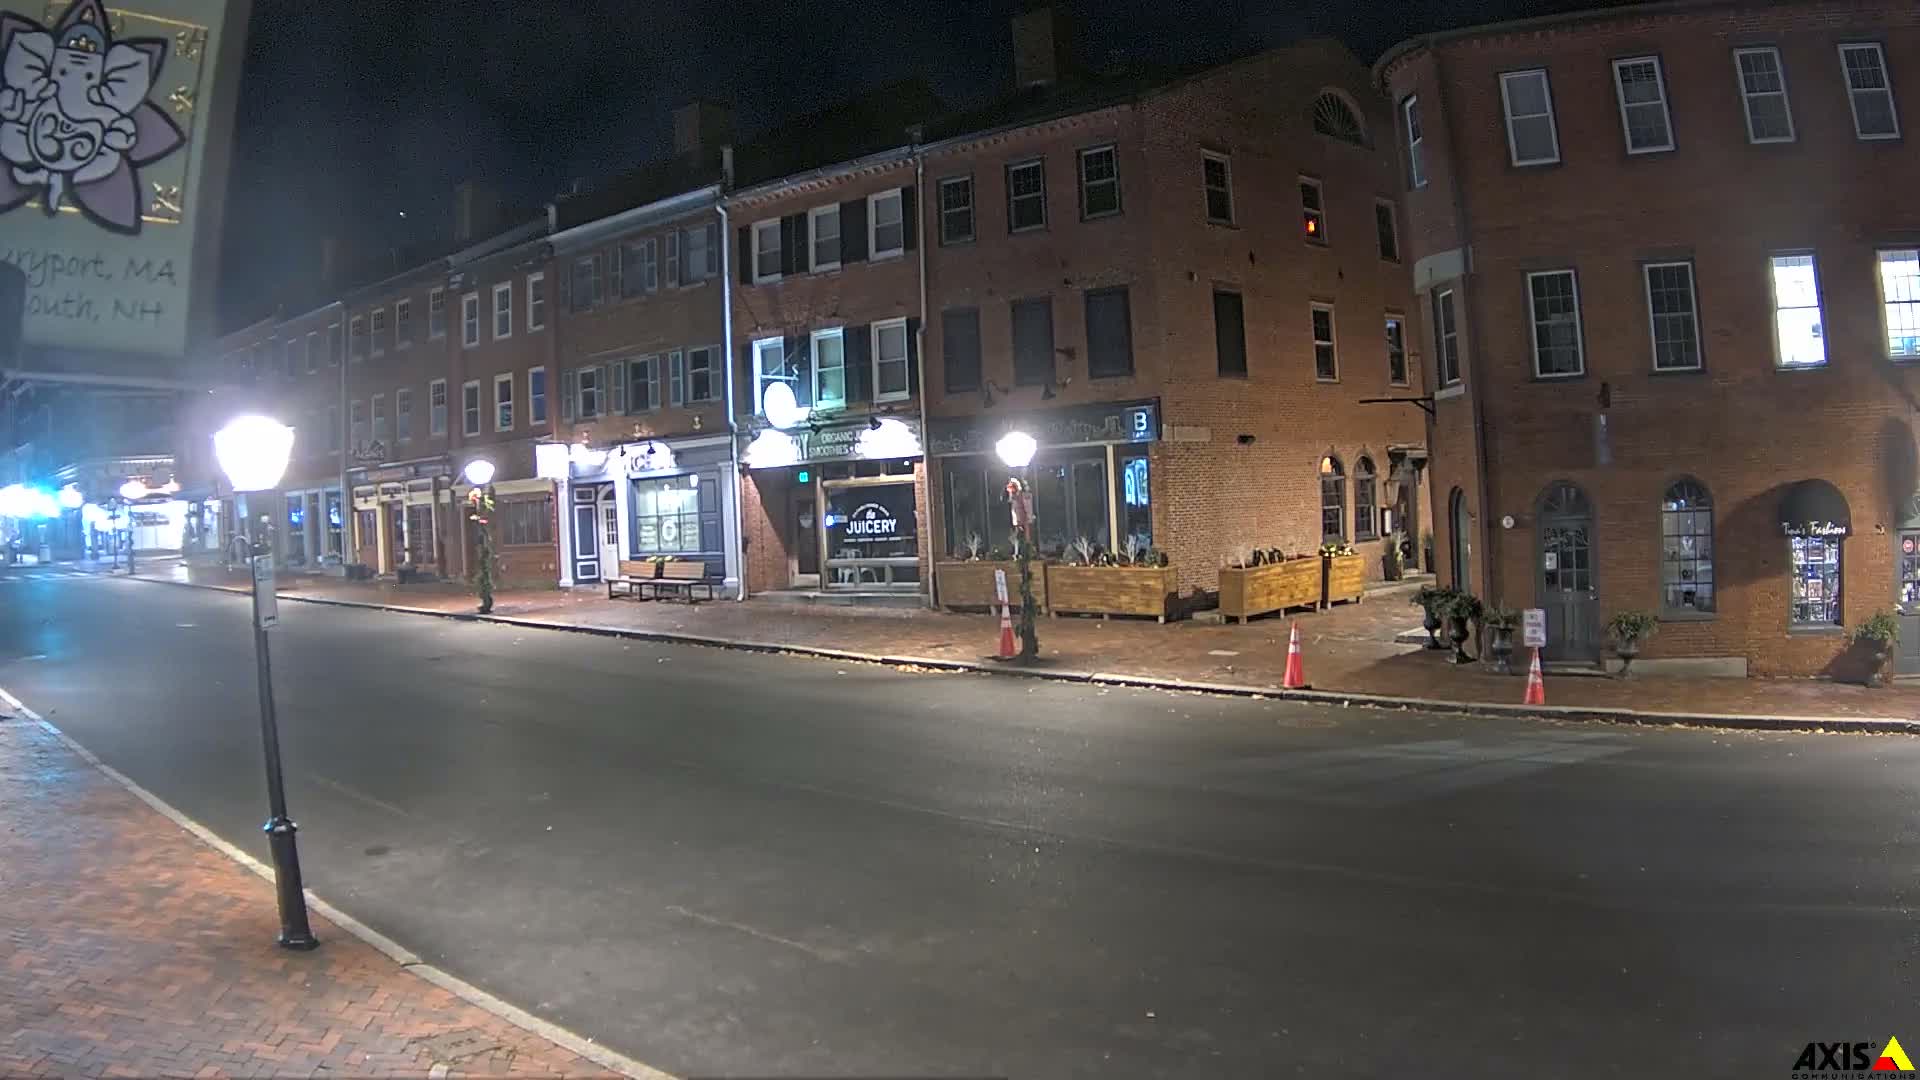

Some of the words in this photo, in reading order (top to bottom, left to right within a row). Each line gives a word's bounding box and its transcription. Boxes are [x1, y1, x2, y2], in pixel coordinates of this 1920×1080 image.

[123, 257, 176, 286] MA
[112, 299, 162, 323] NH
[1134, 411, 1147, 431] B
[821, 431, 853, 444] ORGANIC
[809, 444, 849, 458] SMOOTHIES
[846, 519, 896, 534] JUICERY
[1809, 521, 1846, 536] Fashion
